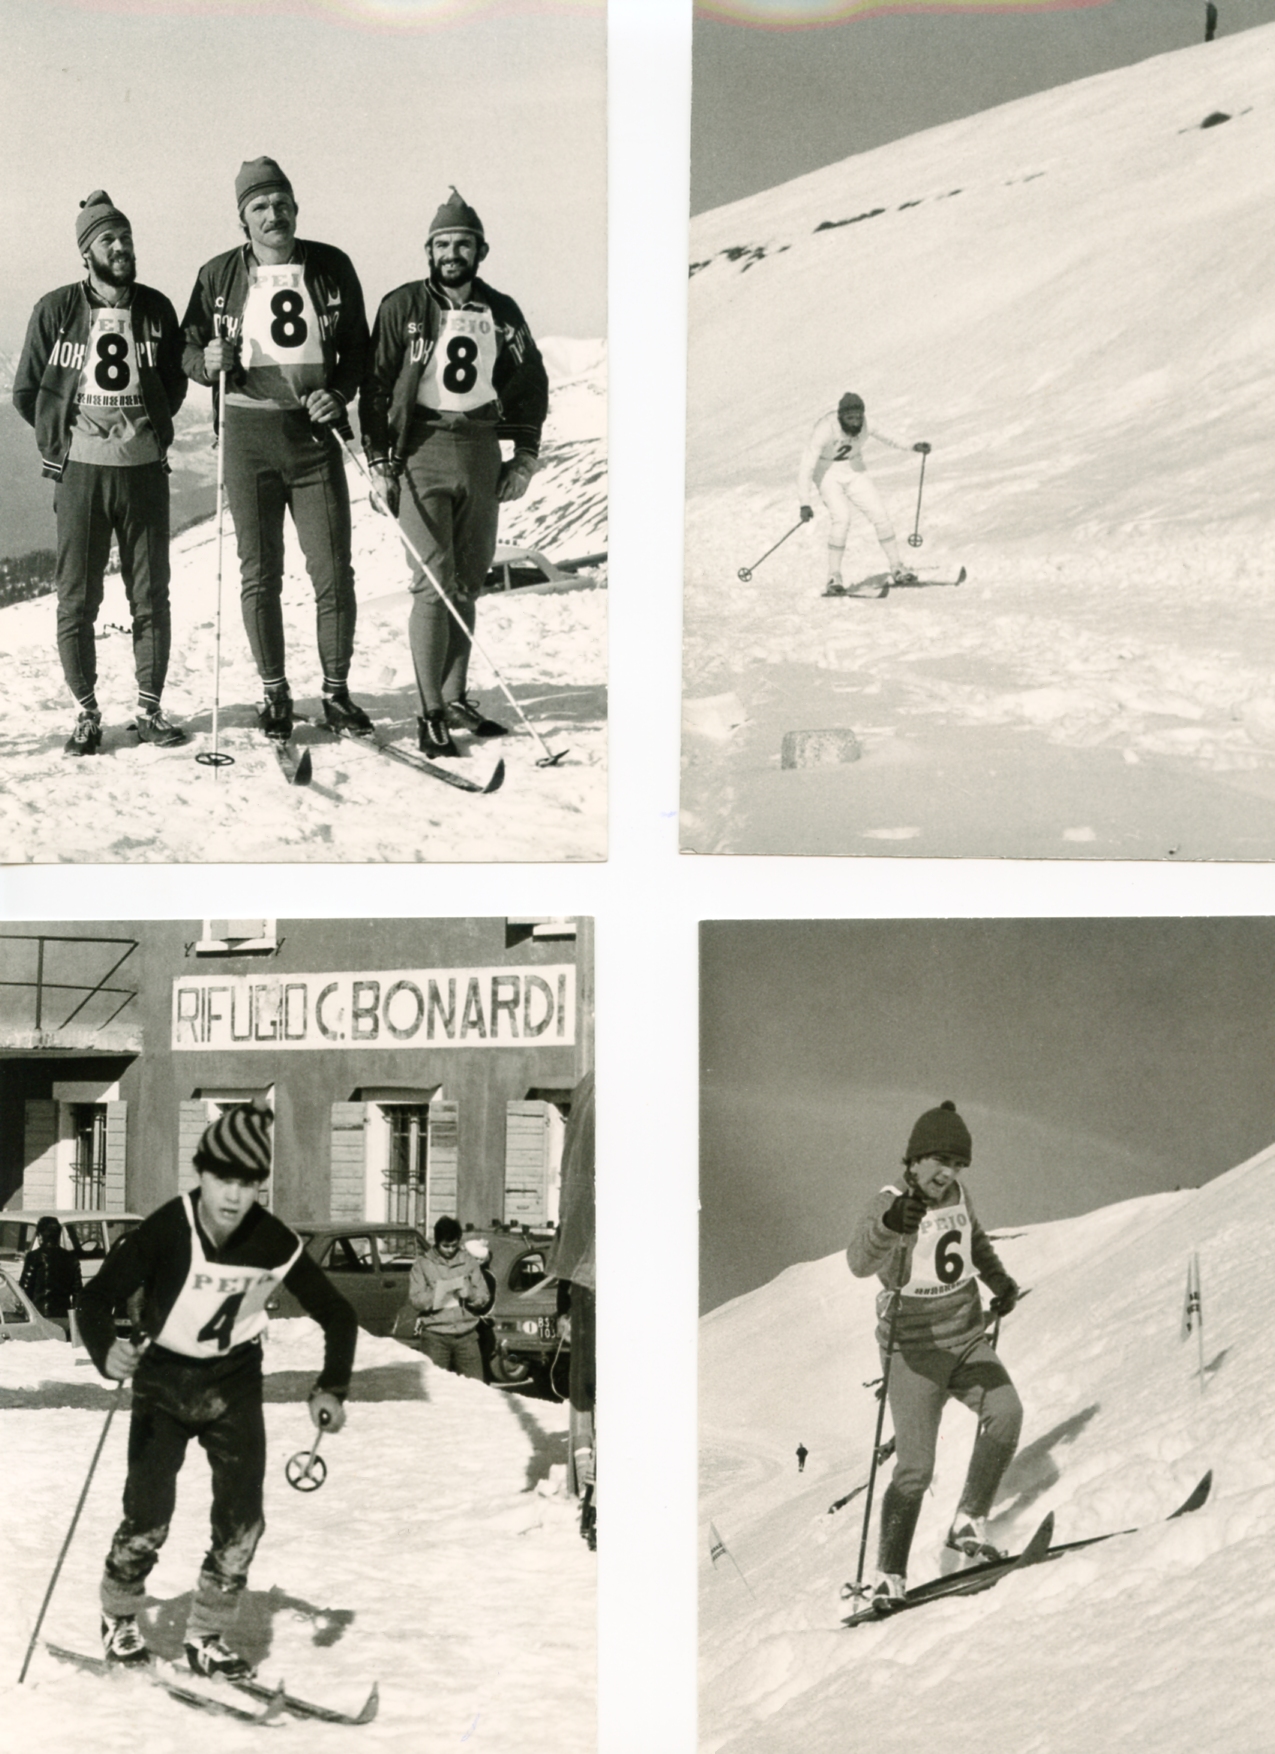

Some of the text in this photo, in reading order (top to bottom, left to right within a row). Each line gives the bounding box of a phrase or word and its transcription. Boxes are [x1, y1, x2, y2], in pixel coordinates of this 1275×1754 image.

[270, 289, 308, 349] 8
[94, 333, 131, 392] 8
[443, 335, 478, 395] 8
[833, 444, 853, 462] 2
[176, 982, 308, 1044] RIFUGIO
[935, 1229, 964, 1285] 6
[197, 1292, 246, 1352] 4
